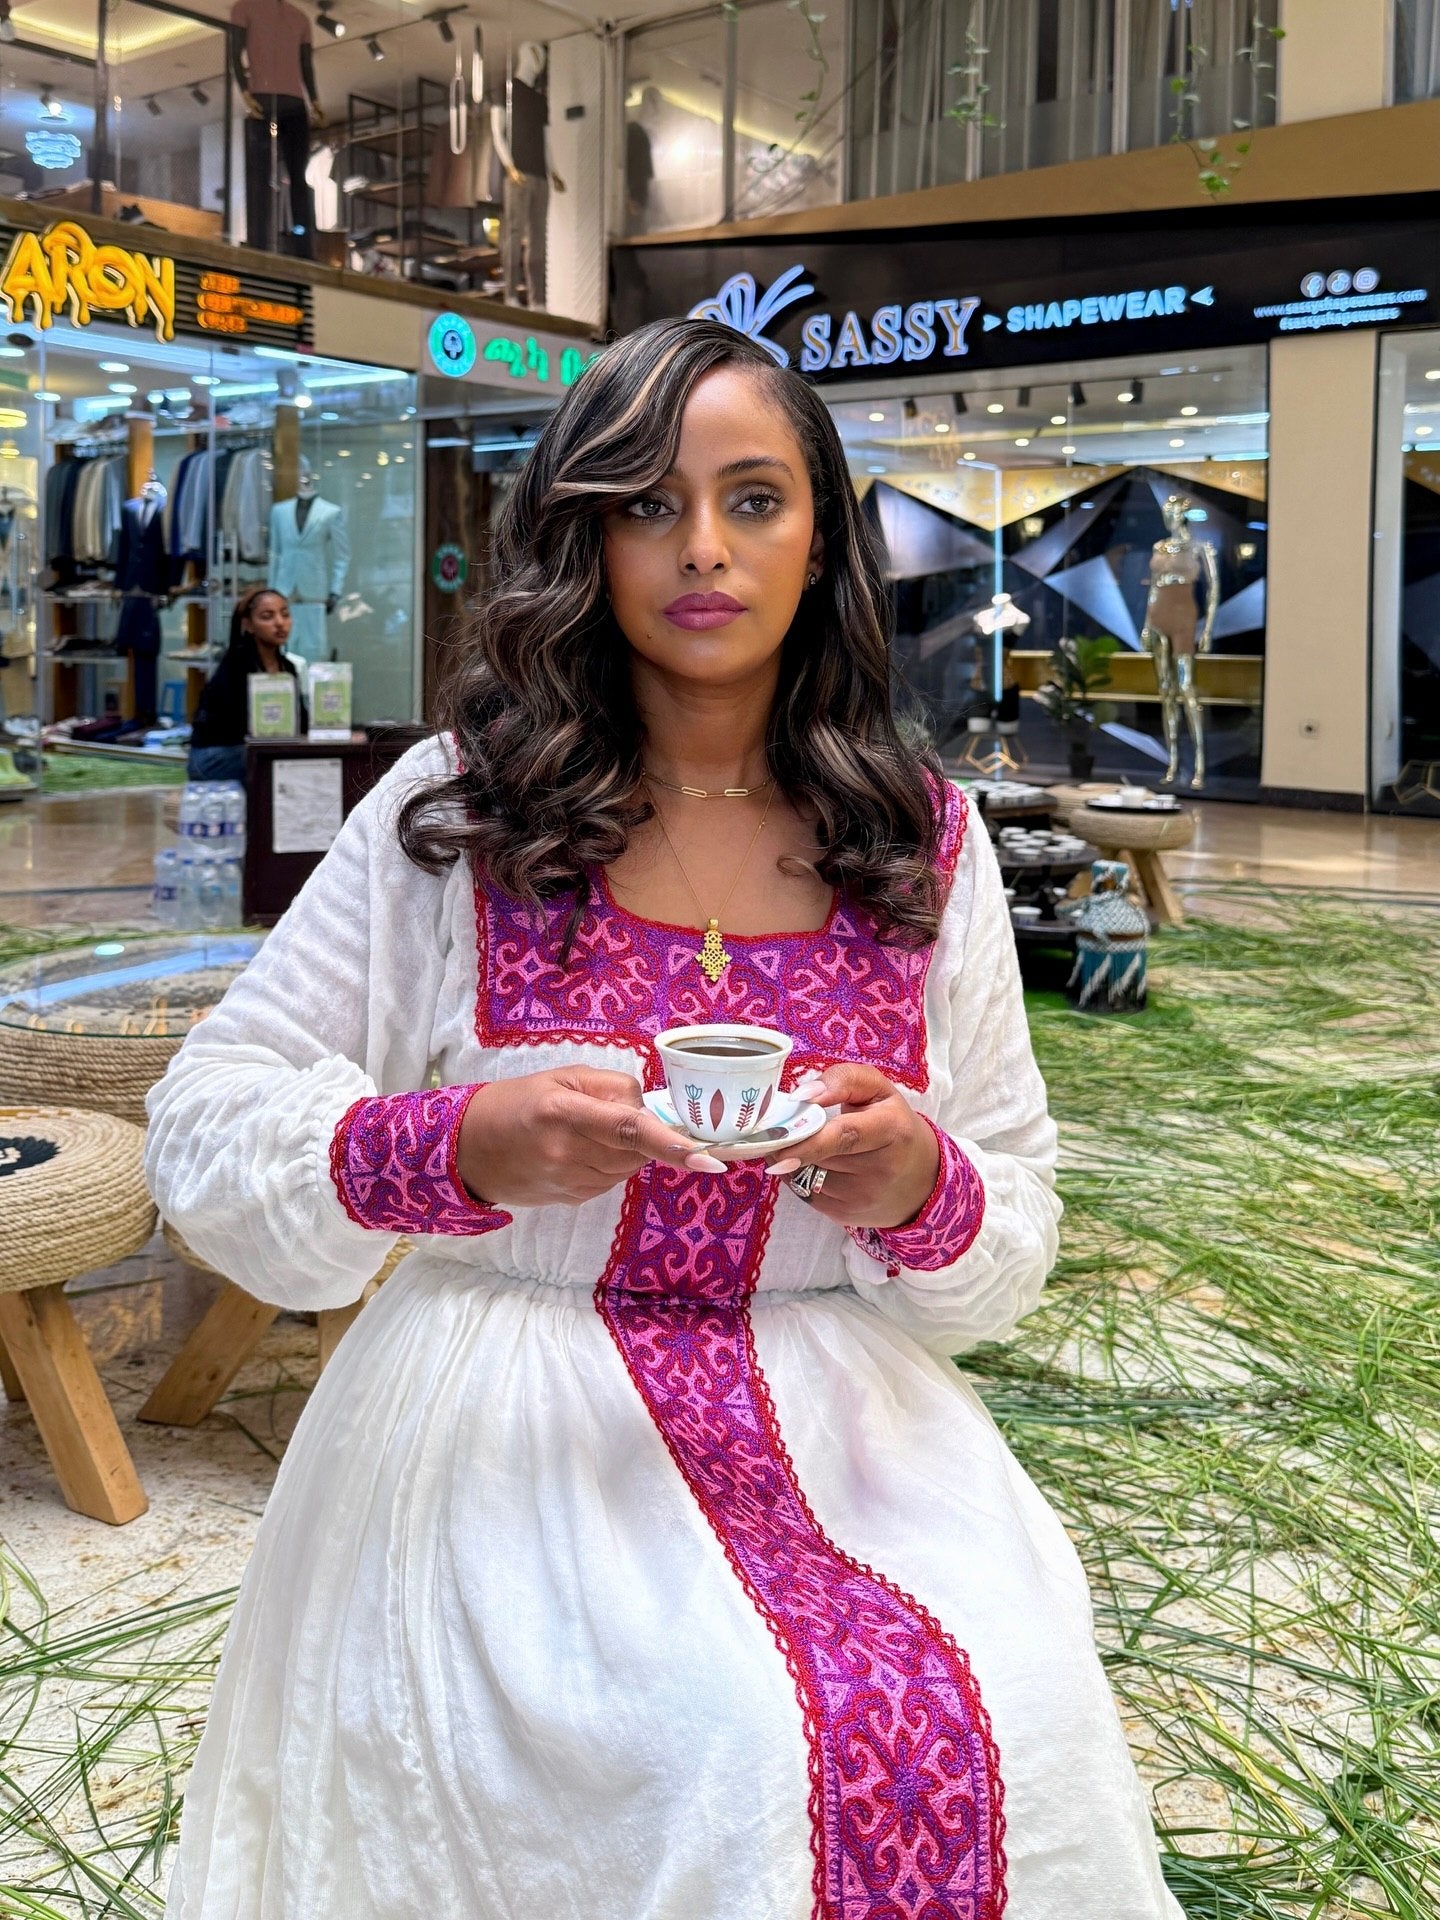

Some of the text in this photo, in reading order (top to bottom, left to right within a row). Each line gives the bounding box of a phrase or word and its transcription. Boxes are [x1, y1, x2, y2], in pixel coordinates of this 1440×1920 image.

[1, 221, 175, 343] ARON
[801, 286, 1187, 372] SASSY SHAPEWEAR
